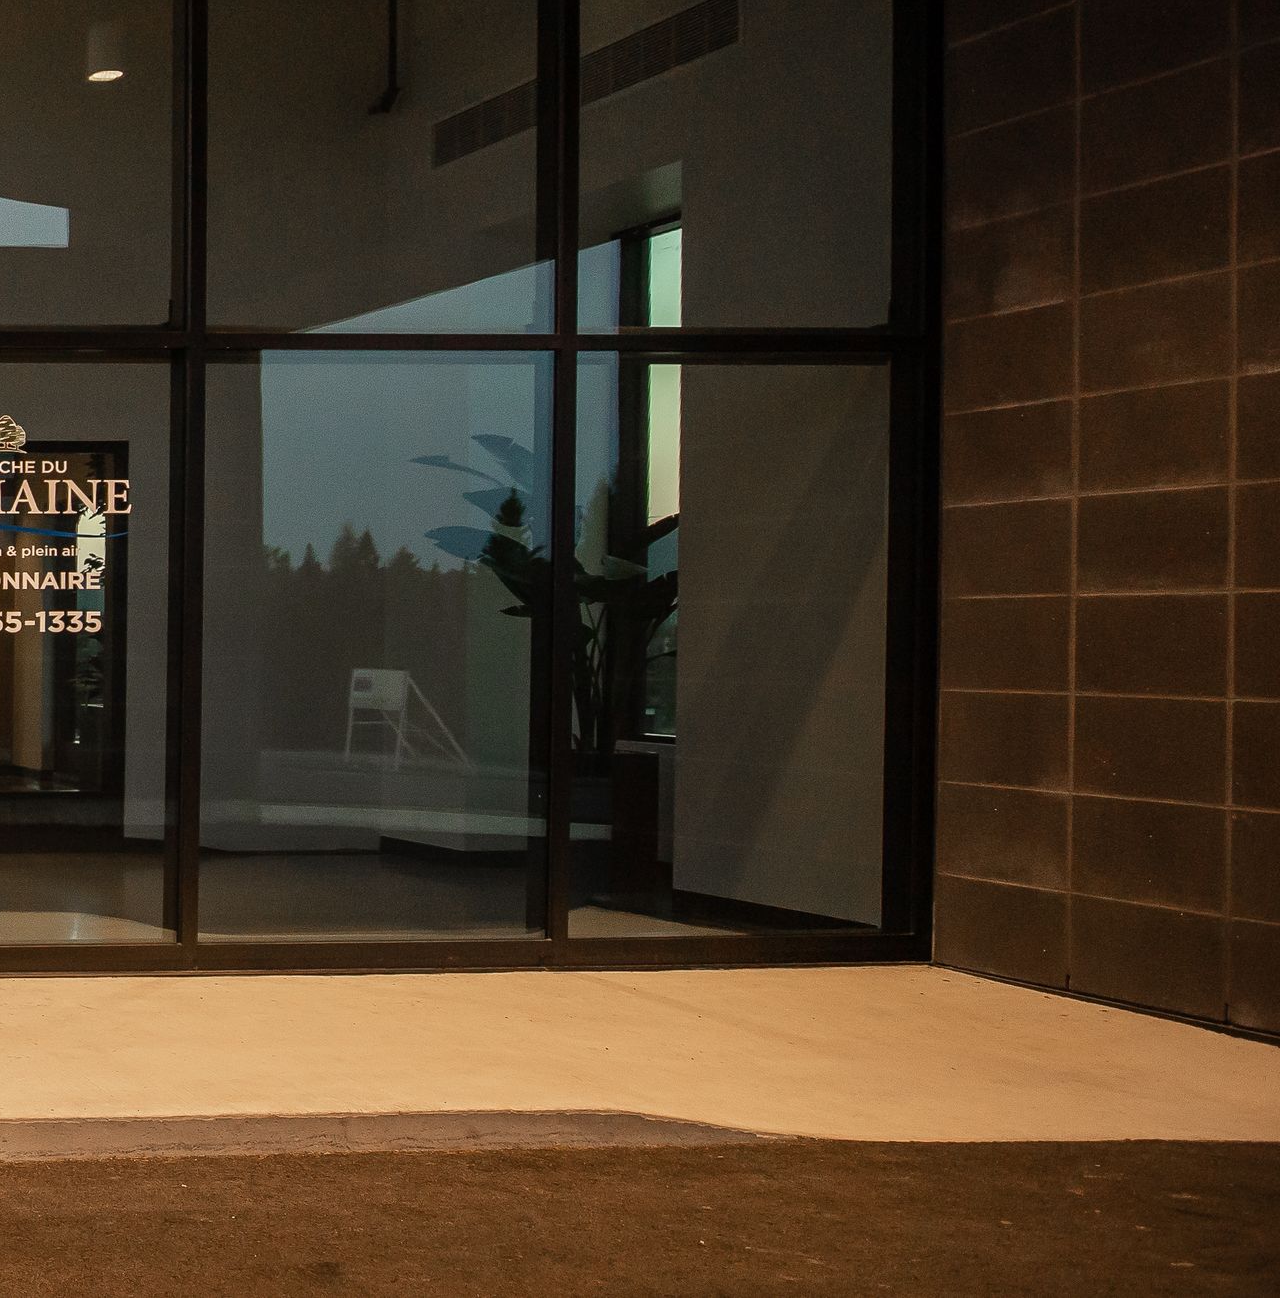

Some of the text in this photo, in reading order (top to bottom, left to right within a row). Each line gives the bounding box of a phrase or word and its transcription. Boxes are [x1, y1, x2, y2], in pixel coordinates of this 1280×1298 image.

[41, 460, 68, 474] DU
[6, 545, 17, 557] &
[21, 545, 58, 559] plein
[61, 545, 81, 557] air
